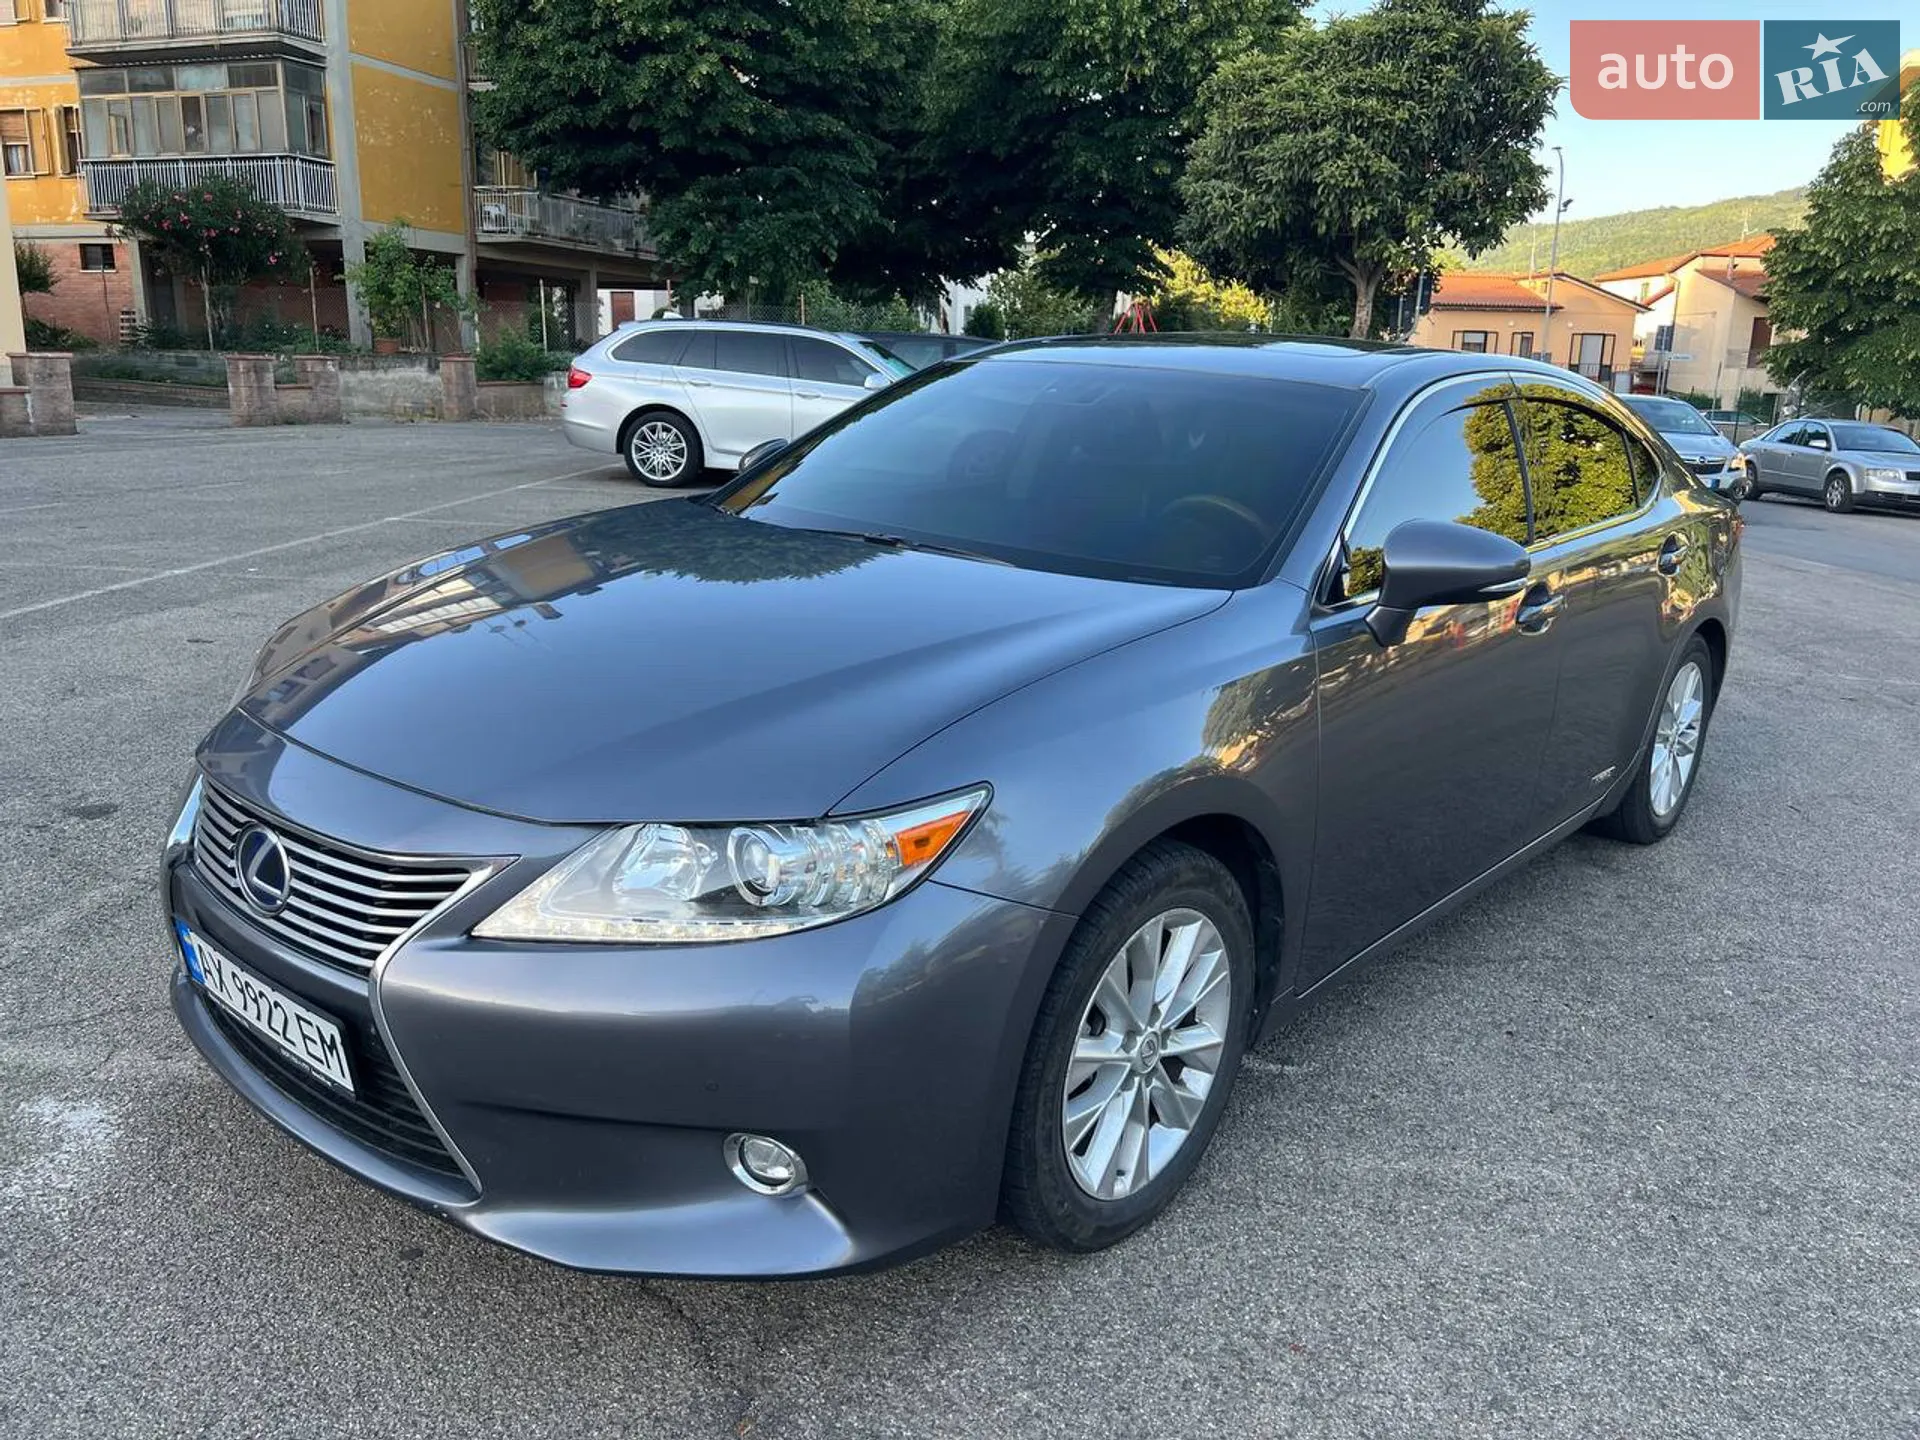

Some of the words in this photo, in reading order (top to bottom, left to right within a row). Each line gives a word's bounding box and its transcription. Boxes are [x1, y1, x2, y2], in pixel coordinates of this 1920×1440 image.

[198, 943, 234, 1001] AX
[231, 971, 297, 1047] 9922
[294, 1011, 346, 1080] EM
